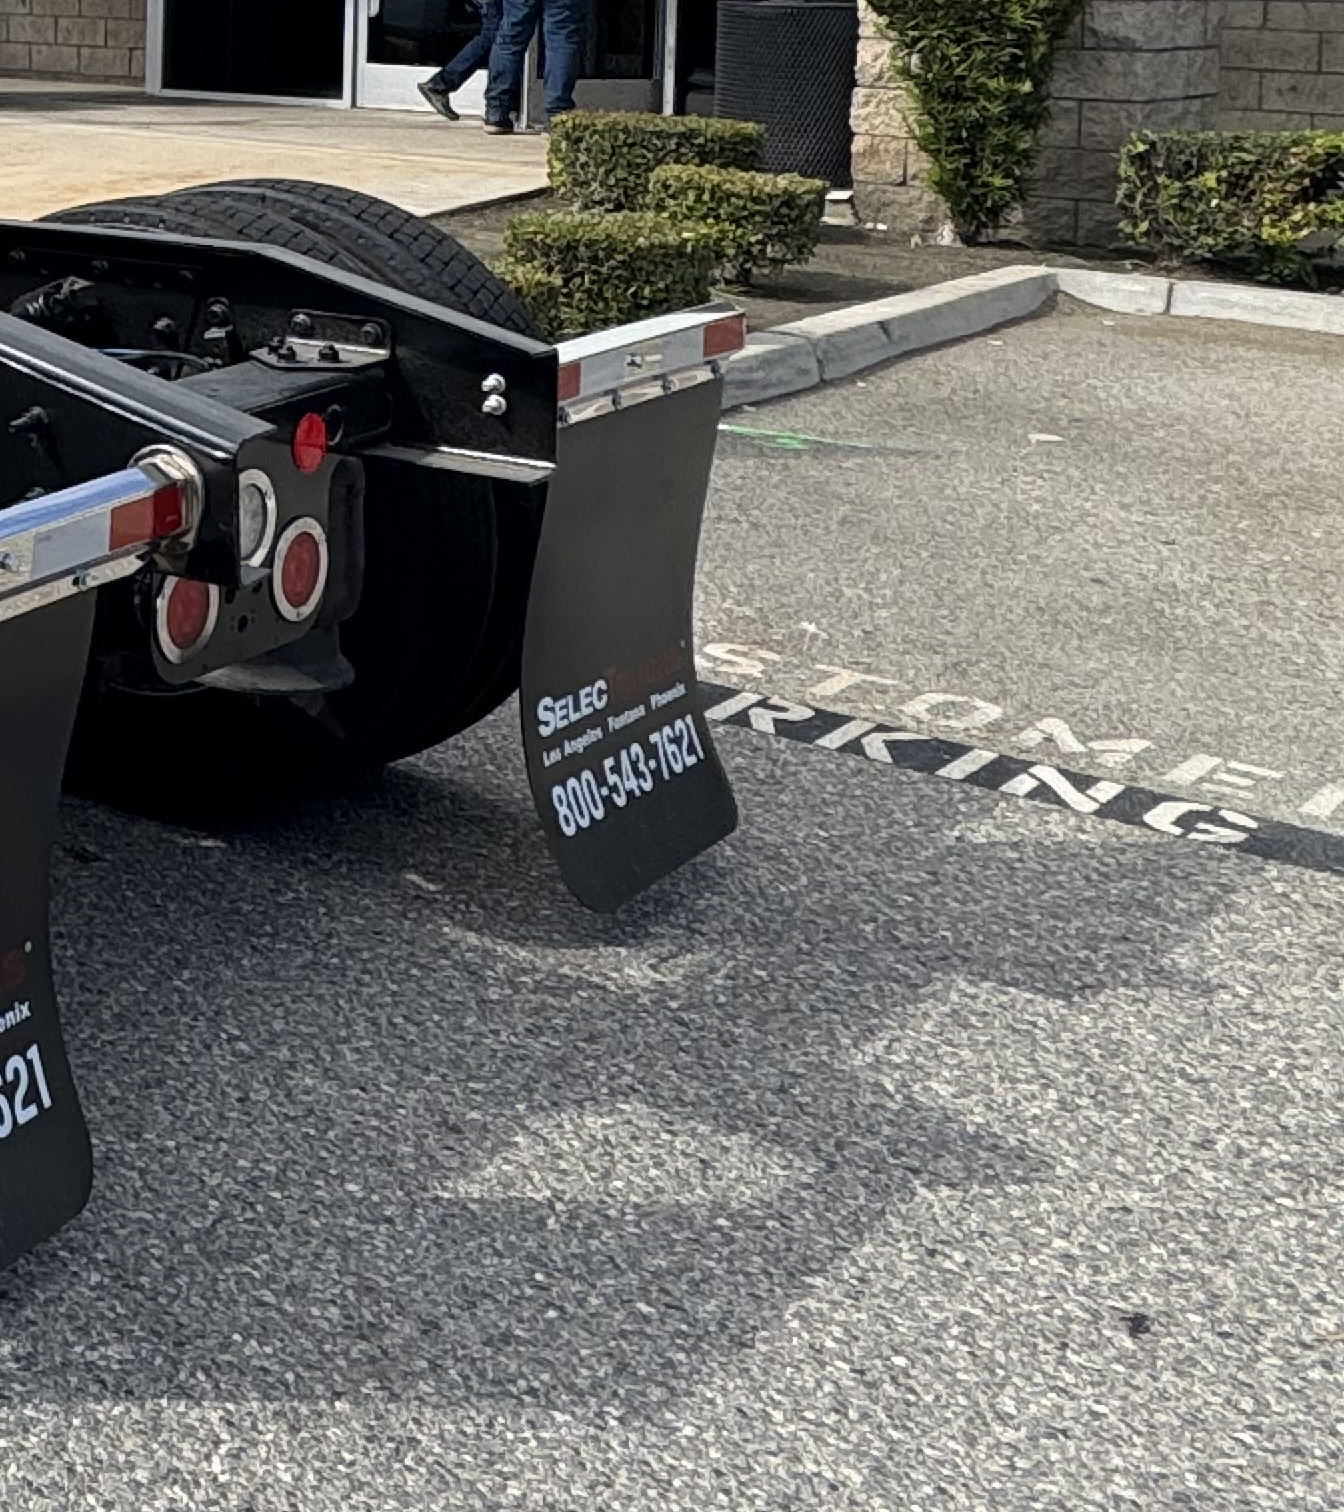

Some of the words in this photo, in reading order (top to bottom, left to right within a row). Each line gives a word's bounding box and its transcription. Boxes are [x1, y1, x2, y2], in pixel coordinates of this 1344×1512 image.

[542, 747, 562, 768] Los
[551, 714, 705, 836] 800-543-7621
[704, 692, 1260, 844] RKING
